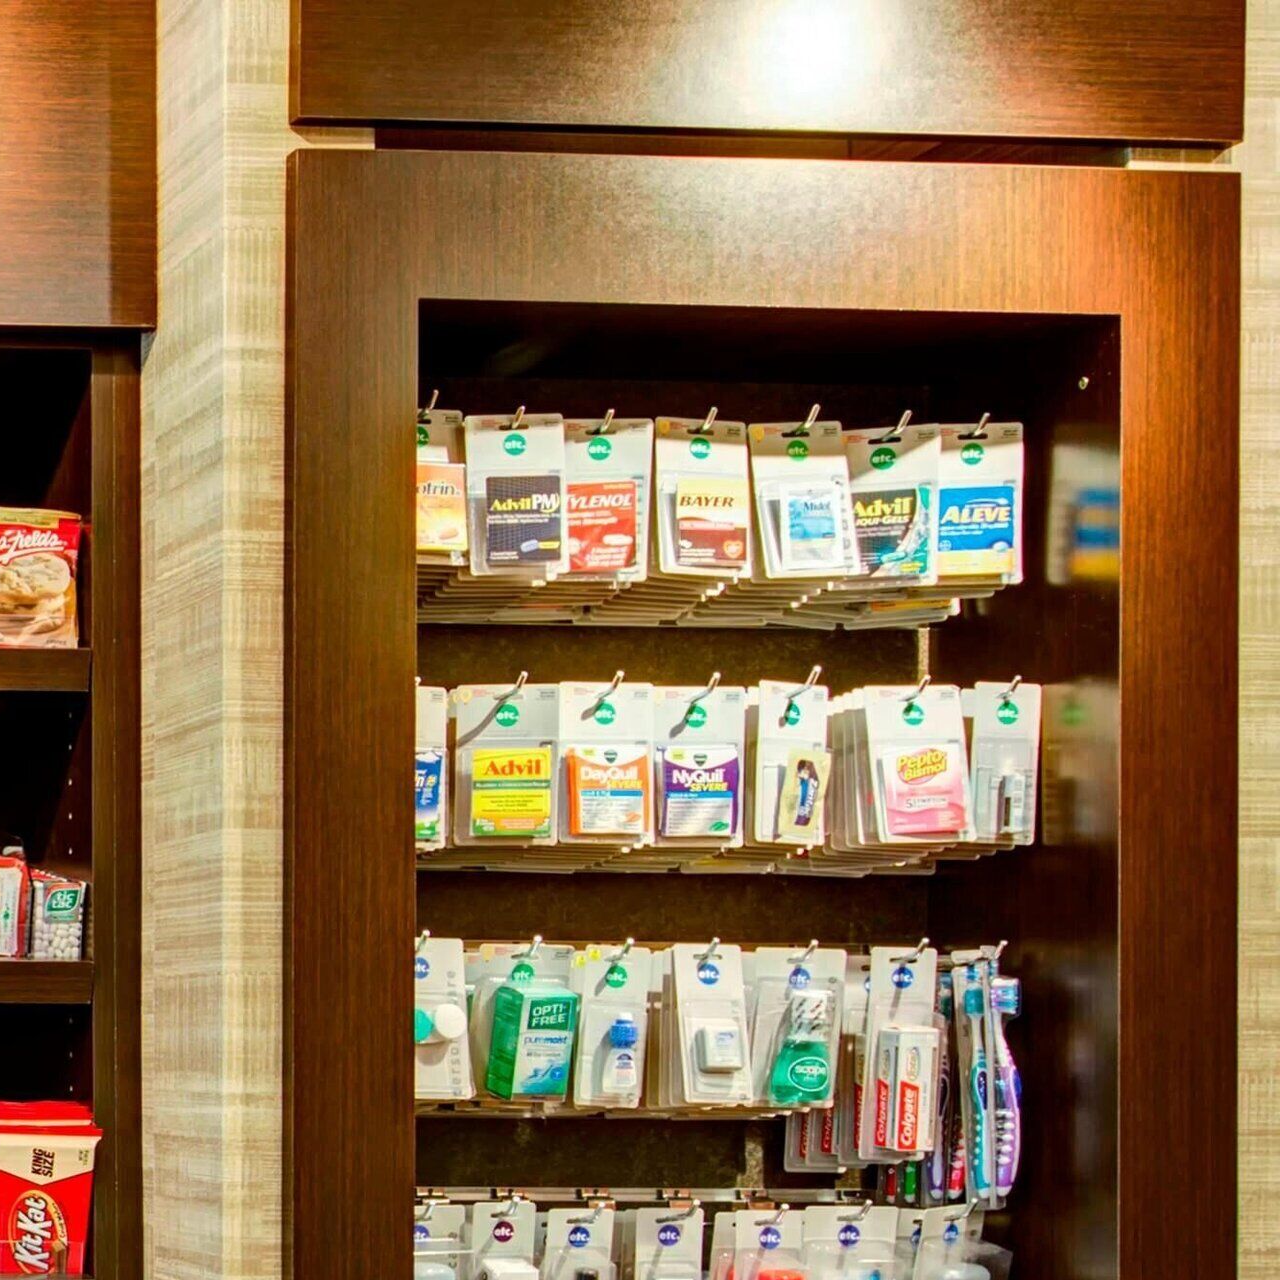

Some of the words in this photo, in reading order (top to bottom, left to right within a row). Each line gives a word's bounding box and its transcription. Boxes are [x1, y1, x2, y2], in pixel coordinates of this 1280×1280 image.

[679, 495, 734, 508] BAYER
[852, 496, 914, 517] Advil
[940, 505, 1013, 526] ALEVE
[483, 759, 542, 777] Advil
[580, 765, 639, 784] DayQuil
[606, 779, 644, 789] SEVERE
[671, 768, 727, 787] NyQuil
[689, 782, 729, 793] SEVERE
[56, 890, 76, 901] tic
[52, 898, 73, 909] tac
[531, 1003, 567, 1017] OPTI-
[531, 1014, 566, 1027] FREE
[874, 1086, 890, 1148] Colgate
[899, 1086, 921, 1147] Colgate
[31, 1148, 43, 1175] KING
[42, 1150, 55, 1178] SIZE
[759, 1233, 782, 1244] etc.
[838, 1230, 861, 1242] etc.
